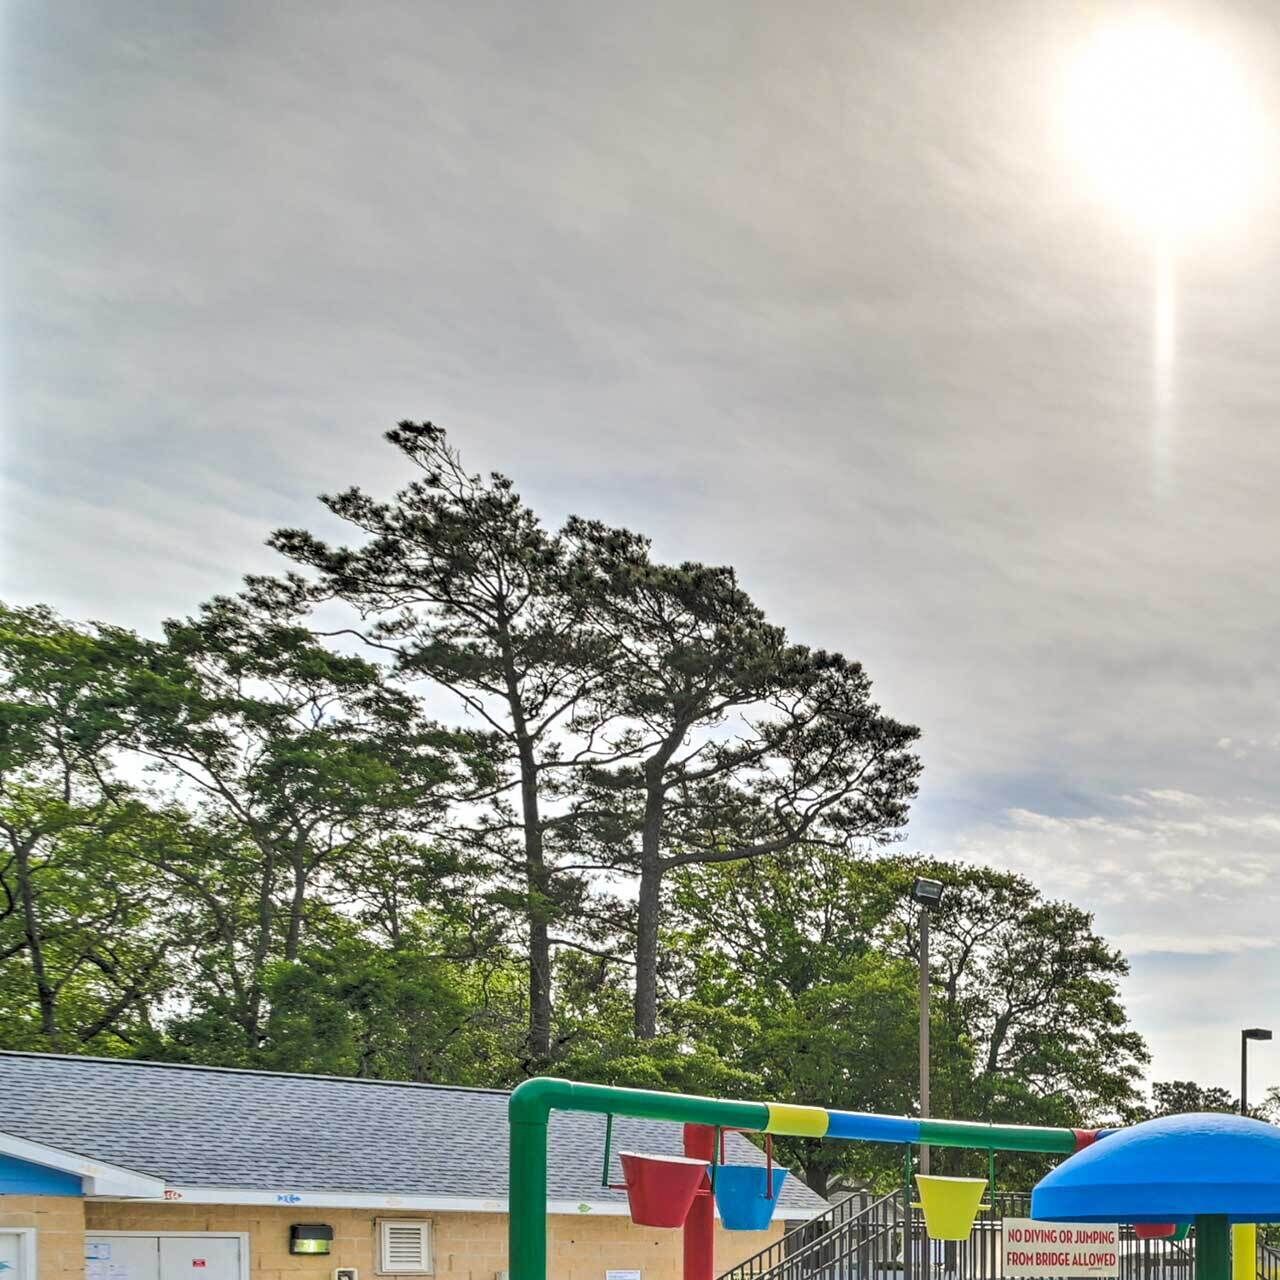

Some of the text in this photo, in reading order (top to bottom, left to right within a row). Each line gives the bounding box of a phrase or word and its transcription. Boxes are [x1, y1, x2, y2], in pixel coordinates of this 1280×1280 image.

[1008, 1229, 1115, 1244] NO DIVING OR JUMPING
[1007, 1252, 1116, 1266] FROM BRIDGE ALLOWED
